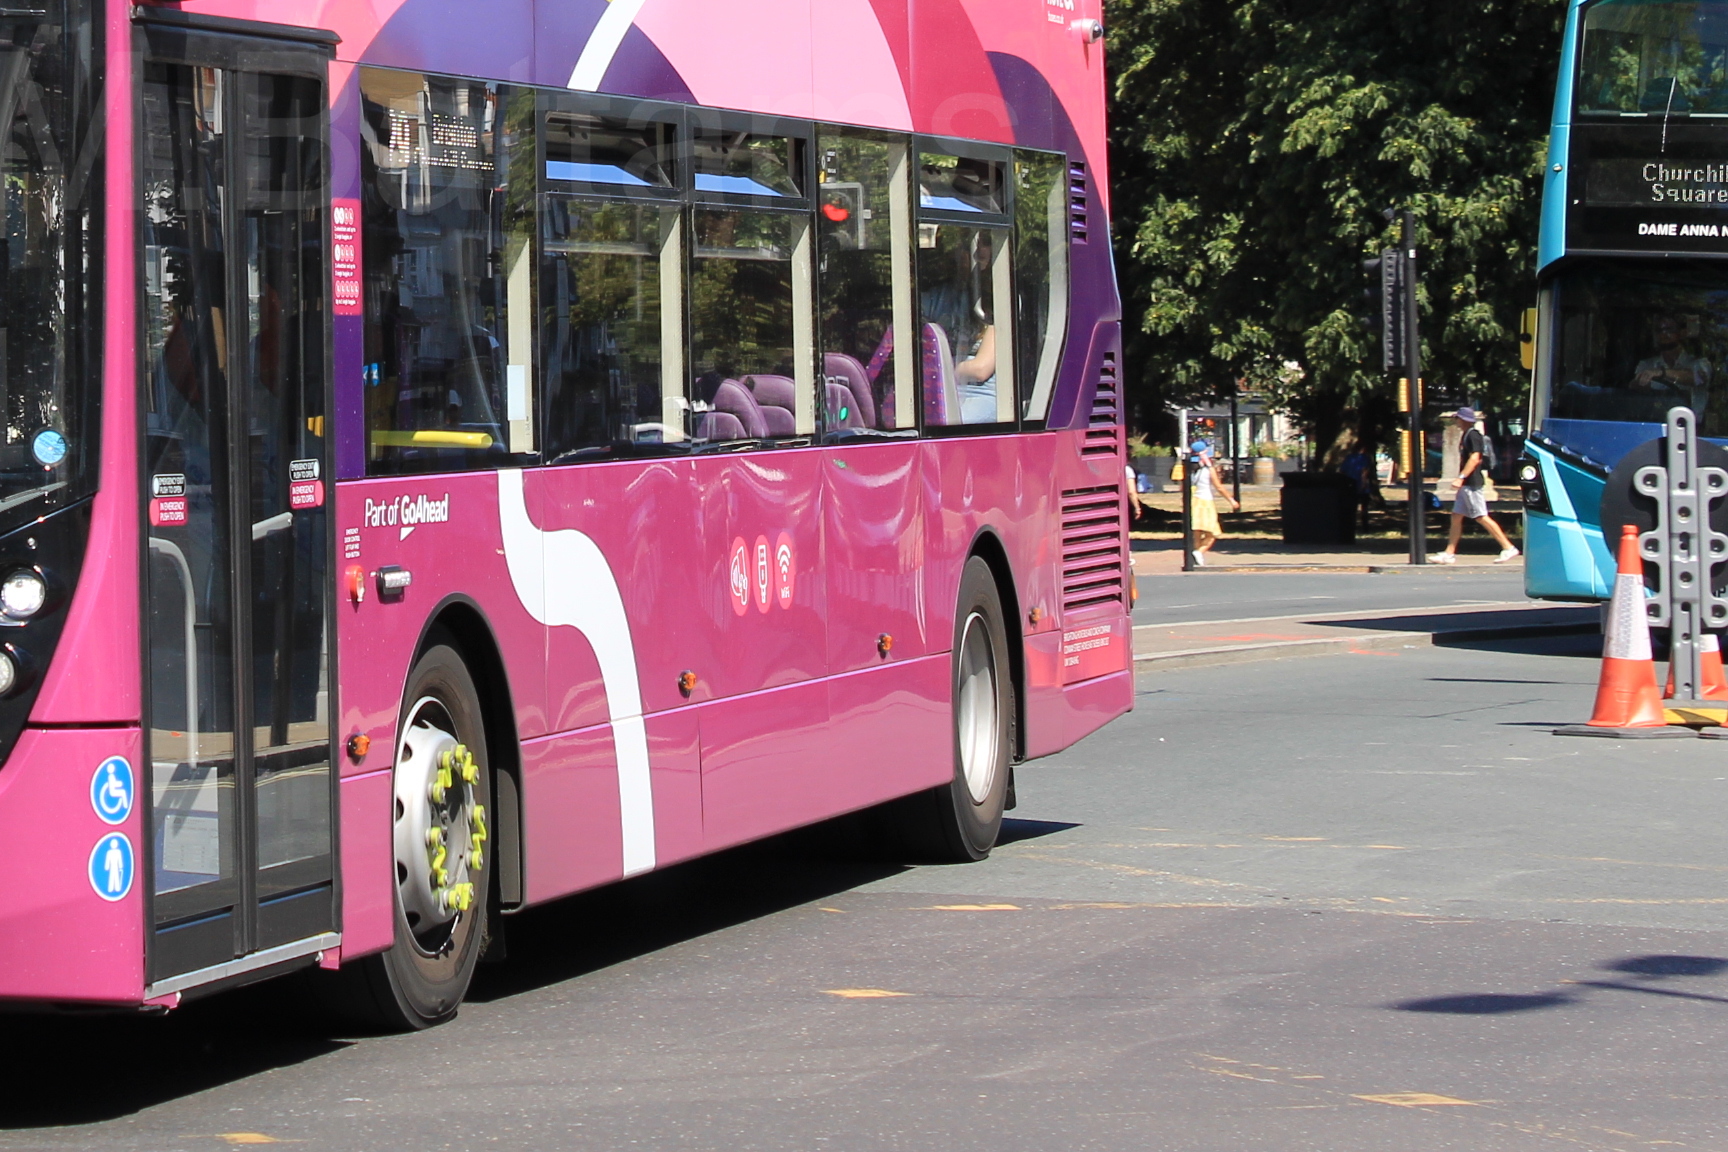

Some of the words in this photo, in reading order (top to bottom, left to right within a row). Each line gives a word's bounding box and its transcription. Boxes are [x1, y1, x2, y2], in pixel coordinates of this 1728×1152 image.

[1652, 183, 1728, 202] Square
[1638, 223, 1677, 236] DAME
[1680, 224, 1719, 237] ANNA
[364, 498, 386, 528] Part
[387, 496, 400, 526] of
[401, 493, 449, 525] GoAhead
